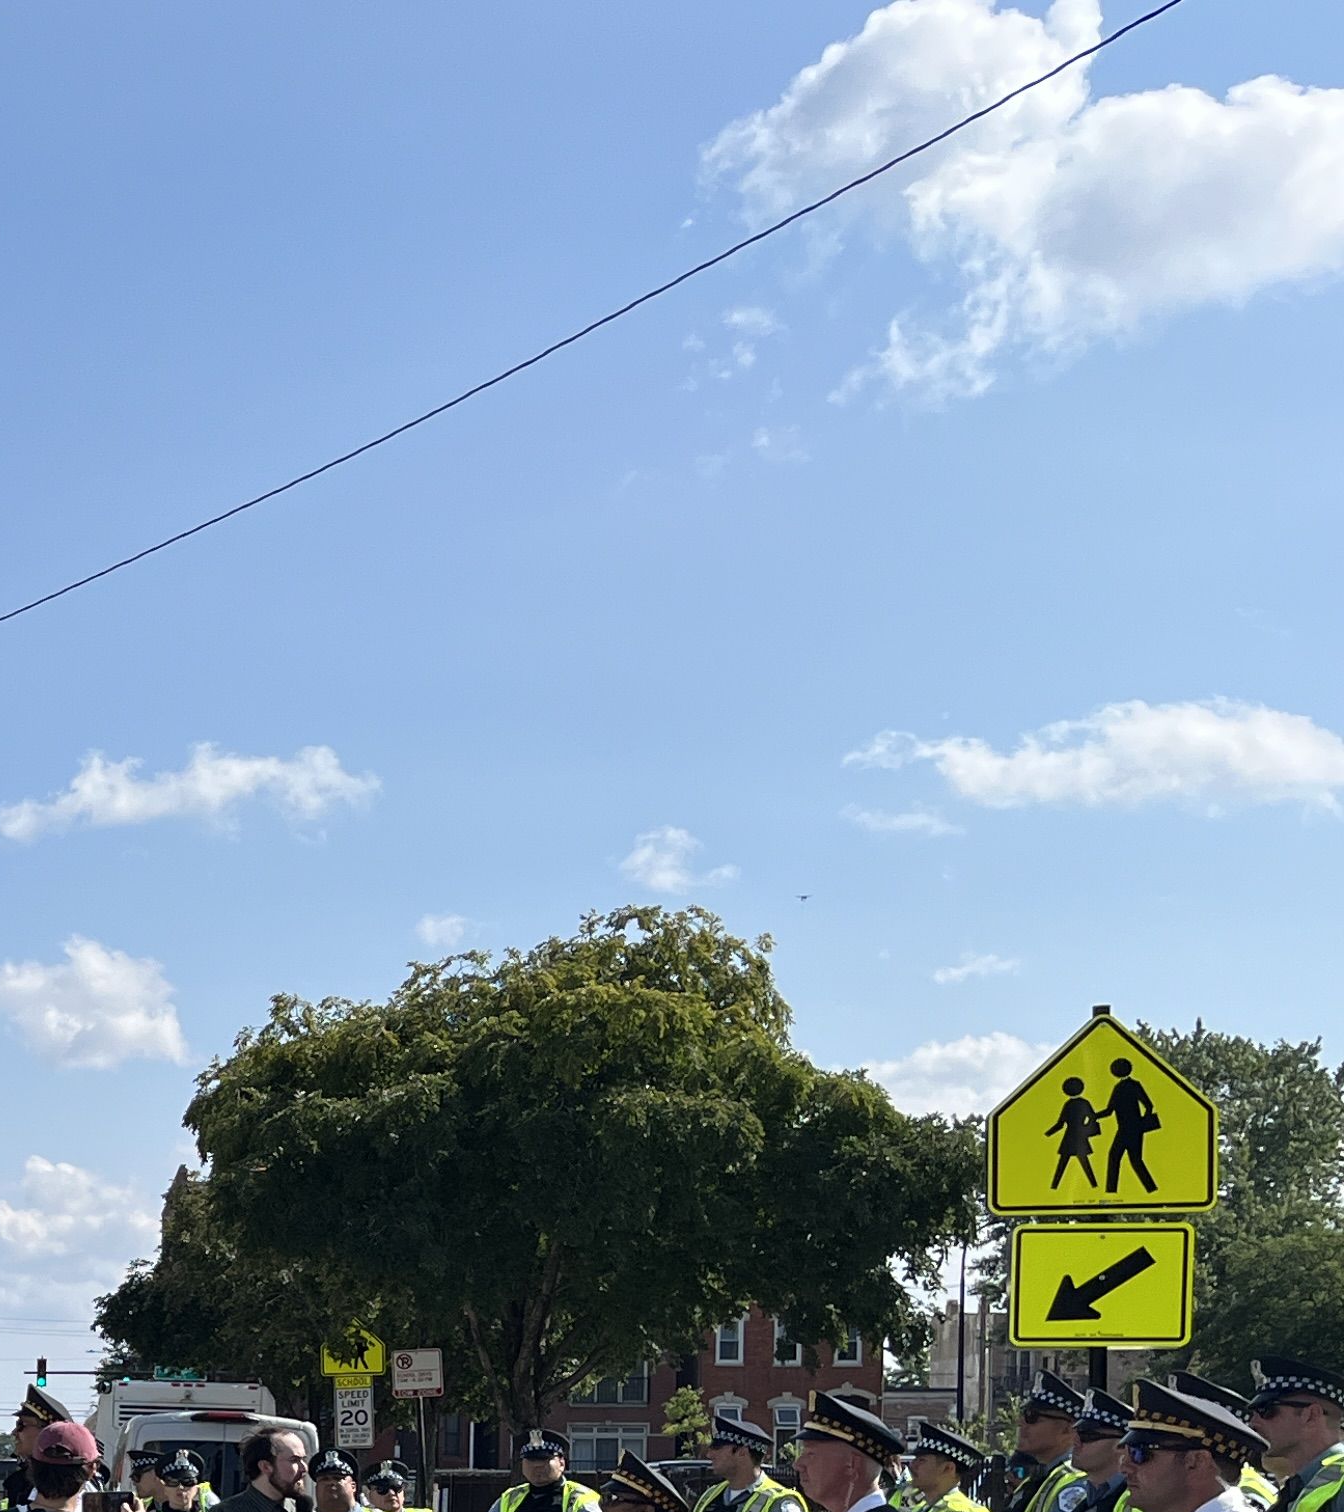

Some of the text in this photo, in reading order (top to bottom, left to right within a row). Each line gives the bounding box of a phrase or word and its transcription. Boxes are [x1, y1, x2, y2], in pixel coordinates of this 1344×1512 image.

[337, 1377, 370, 1386] SCHOOL
[338, 1390, 369, 1399] SPEED
[342, 1400, 366, 1408] LIMIT
[340, 1409, 369, 1426] 20
